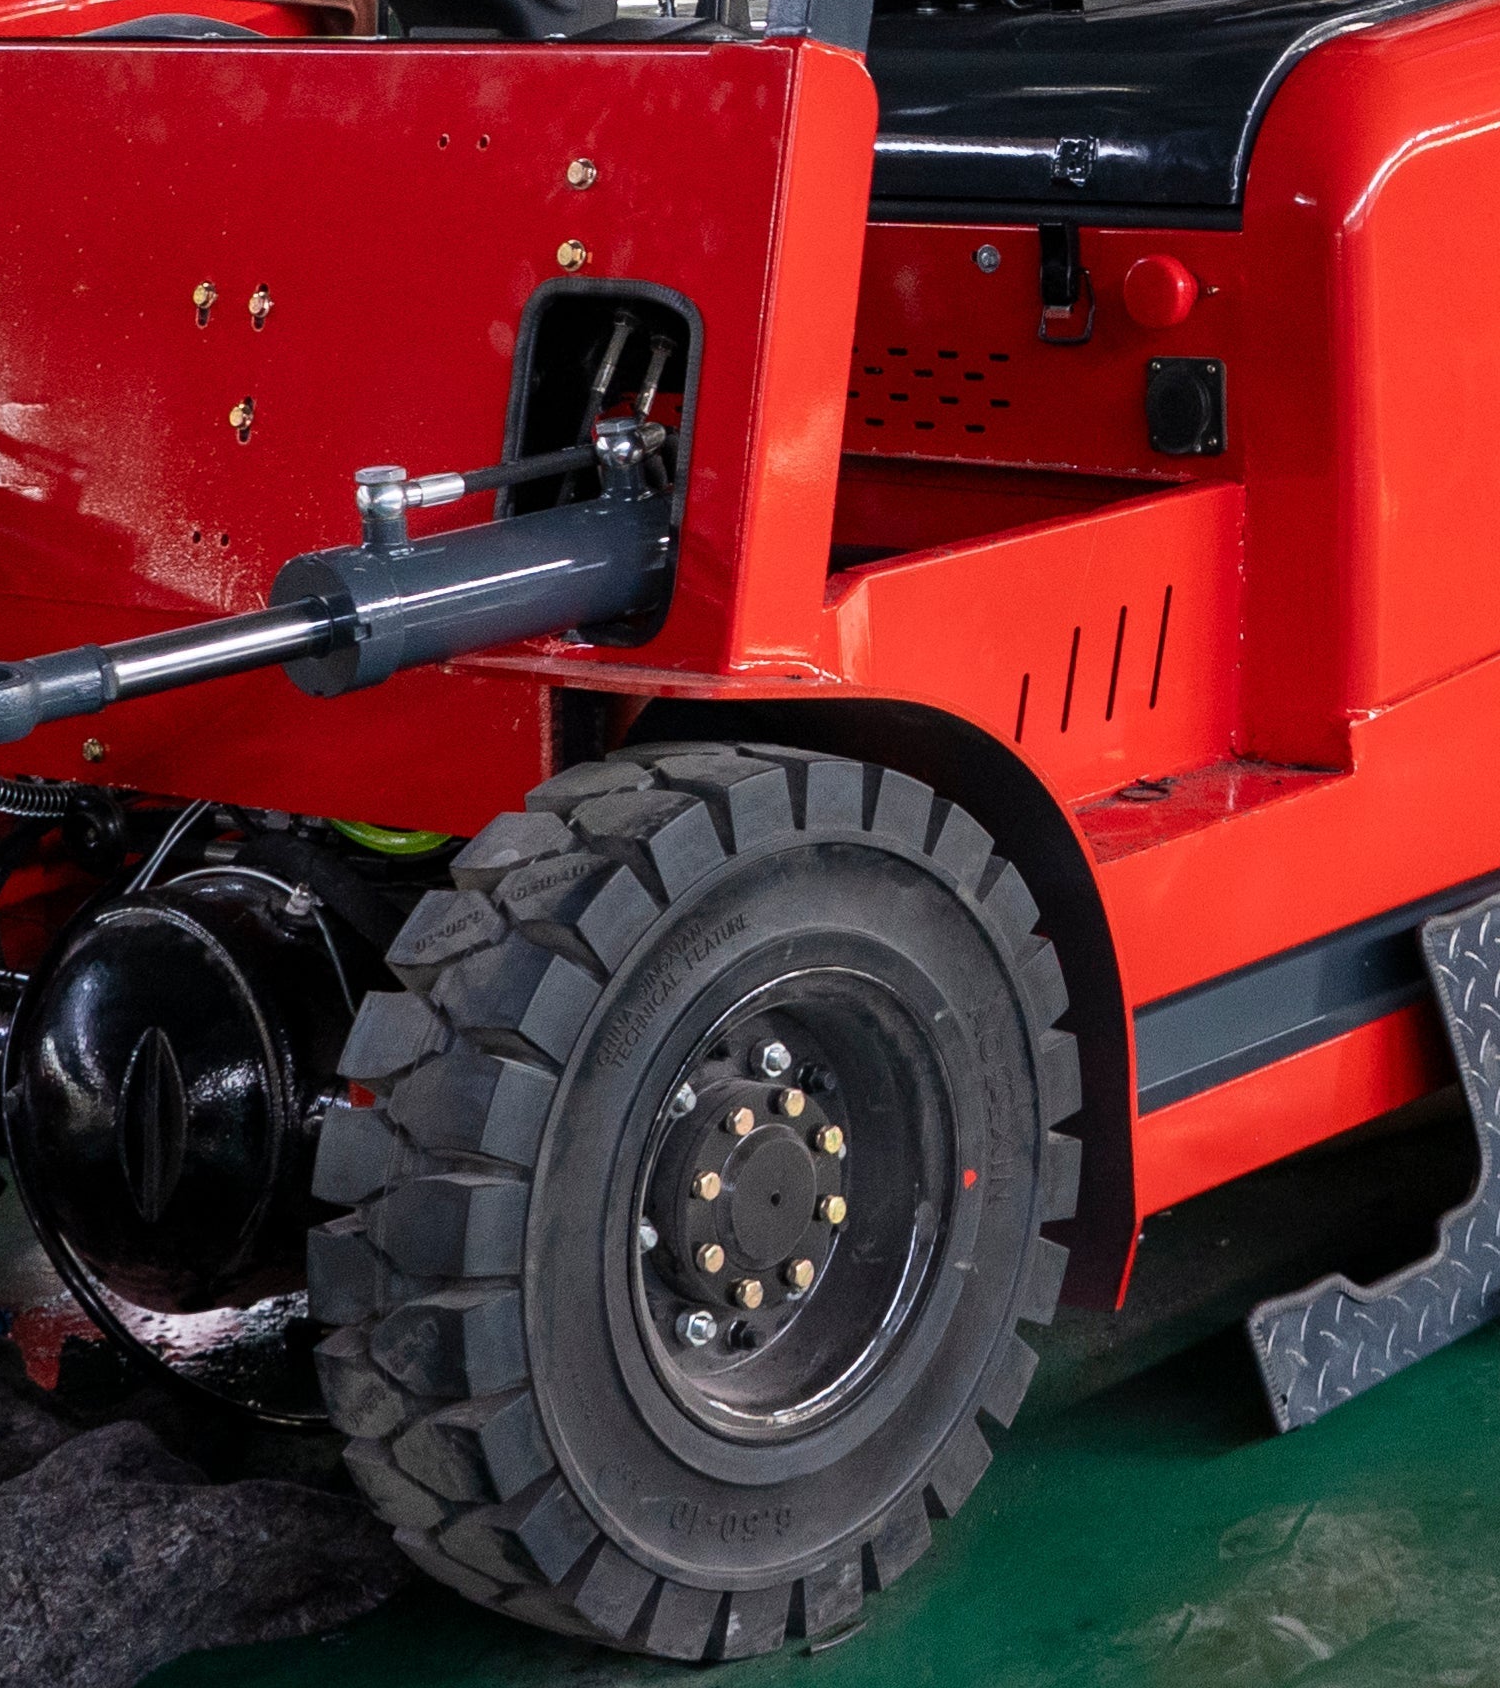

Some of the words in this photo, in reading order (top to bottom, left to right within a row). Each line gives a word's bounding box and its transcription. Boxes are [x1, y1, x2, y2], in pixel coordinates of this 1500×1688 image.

[596, 1007, 637, 1068] CHINA
[610, 972, 684, 1069] TECHNICAL
[683, 912, 751, 971] FEATURE
